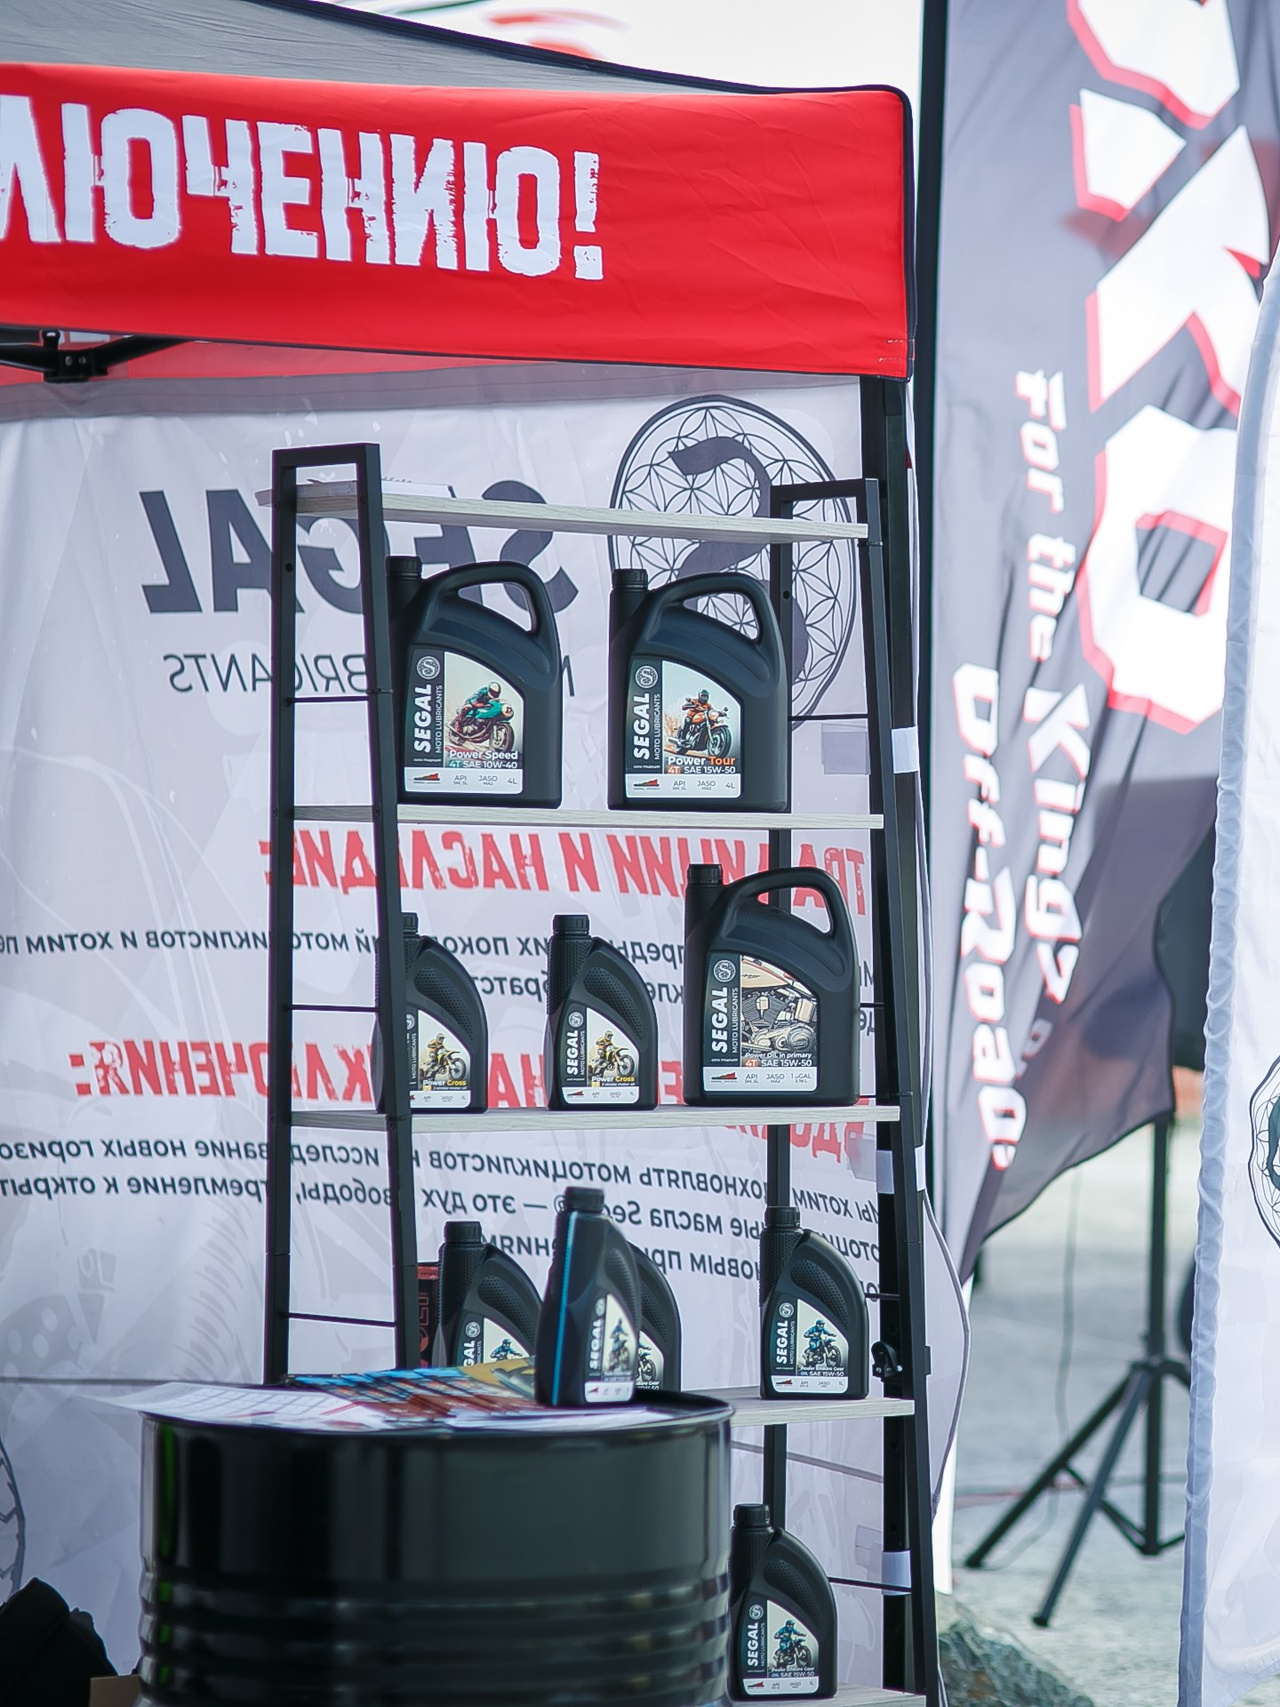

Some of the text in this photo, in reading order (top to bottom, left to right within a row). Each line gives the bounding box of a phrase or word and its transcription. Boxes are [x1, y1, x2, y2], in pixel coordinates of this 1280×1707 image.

[1015, 368, 1068, 512] For
[1026, 535, 1075, 662] the
[413, 684, 432, 753] SEGAL
[435, 685, 443, 728] LUBRICANTS
[633, 693, 650, 760] SEGAL
[449, 750, 518, 761] Power Speed
[449, 760, 460, 768] 4T
[483, 761, 518, 769] 10W-40
[667, 756, 736, 766] Power Tour
[668, 766, 679, 774] 4T
[684, 766, 702, 774] SAE
[704, 766, 736, 774] 15W-50
[711, 987, 728, 1053] SEGAL
[567, 1030, 579, 1075] SEGAL
[464, 1340, 475, 1367] GAL
[776, 1321, 788, 1364] SEGAL
[747, 1622, 758, 1666] SEGAL
